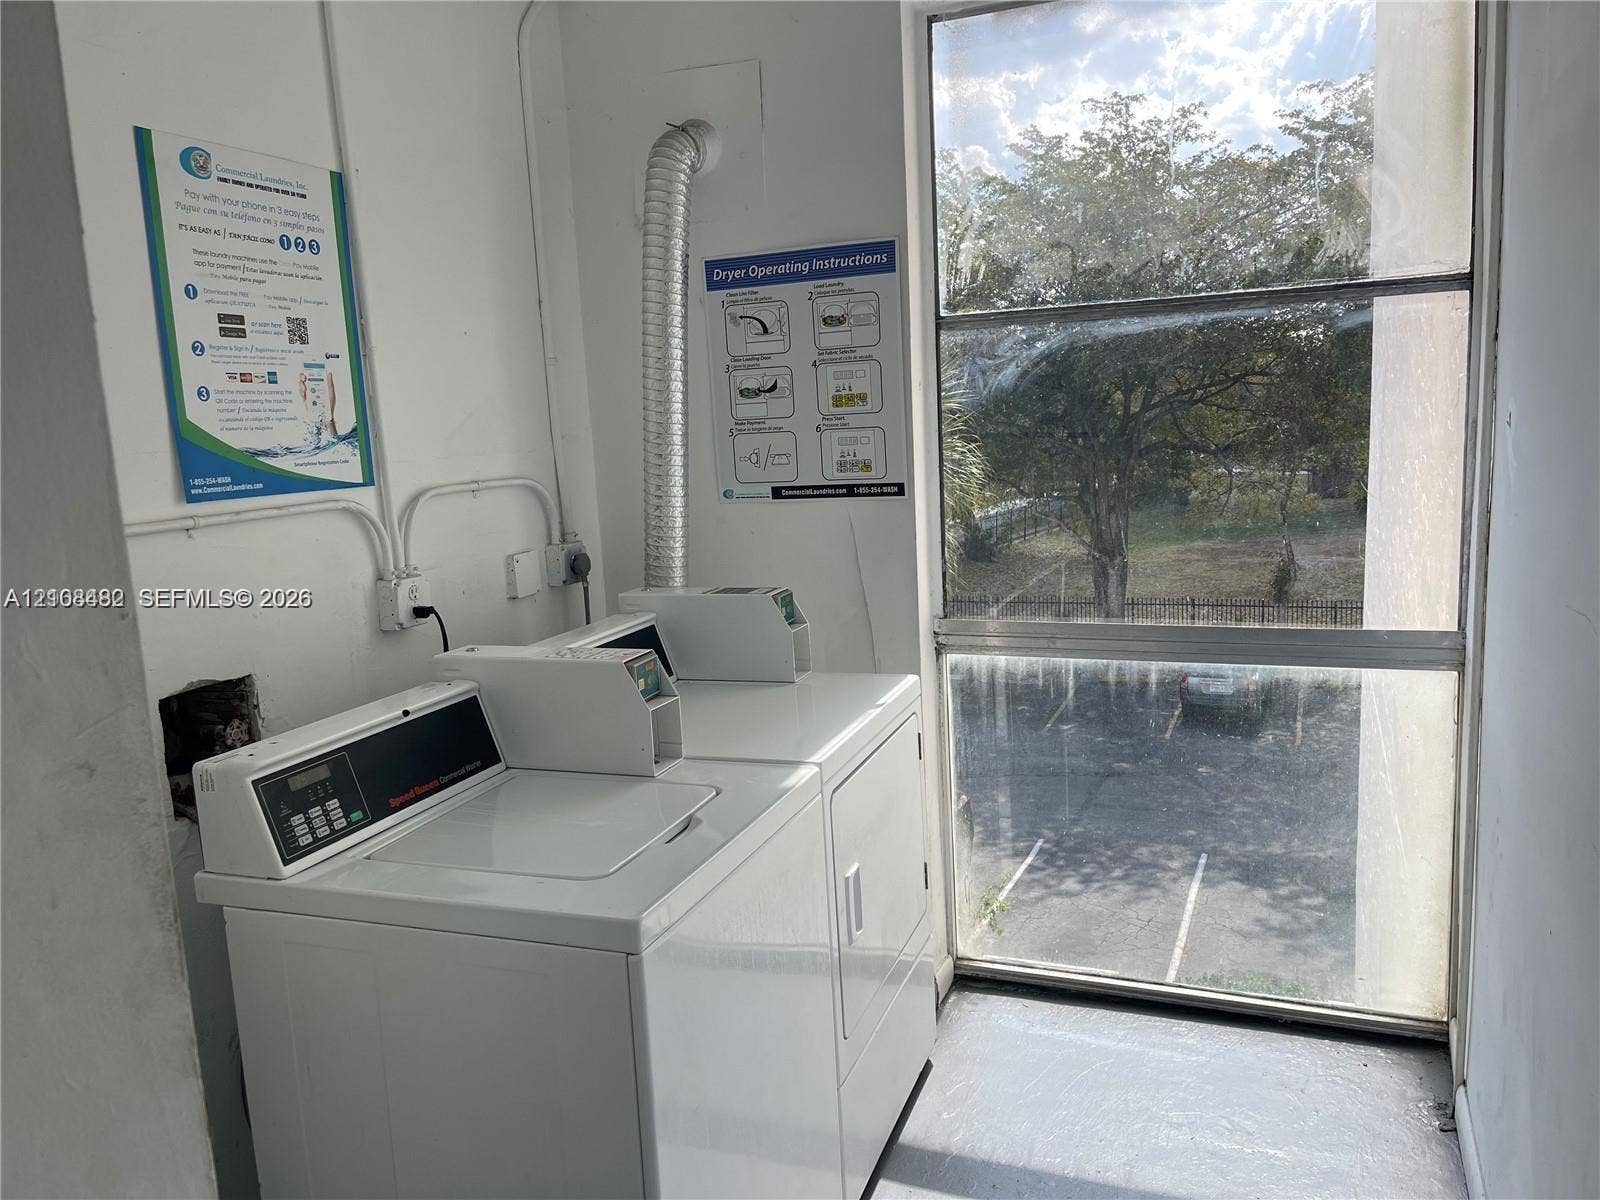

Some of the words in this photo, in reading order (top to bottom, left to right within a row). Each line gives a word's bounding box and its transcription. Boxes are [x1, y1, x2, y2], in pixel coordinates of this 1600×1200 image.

[215, 163, 258, 181] Commercial
[184, 188, 201, 201] Pay
[202, 192, 220, 204] with
[221, 196, 240, 208] your
[241, 198, 267, 213] phone
[269, 204, 276, 214] in
[277, 205, 283, 214] 3
[283, 208, 301, 219] easy
[301, 210, 320, 222] steps
[175, 201, 201, 214] Pague
[203, 206, 218, 215] con
[220, 209, 229, 218] su
[262, 217, 272, 225] en
[306, 226, 325, 235] pasos
[178, 223, 189, 231] IT'S
[198, 226, 212, 235] EASY
[228, 231, 241, 239] TAN
[192, 249, 209, 257] These
[209, 250, 231, 260] laundry
[231, 254, 258, 264] machines
[268, 258, 277, 266] the
[193, 259, 207, 267] app
[207, 260, 216, 268] for
[216, 263, 242, 273] payment
[713, 266, 747, 283] Dryer
[749, 258, 811, 277] Operating
[812, 251, 888, 271] Instructions
[203, 287, 229, 296] Download
[807, 291, 813, 301] 2
[270, 321, 282, 329] here
[724, 364, 730, 373] 3
[811, 359, 817, 368] 4
[728, 428, 734, 437] 5
[815, 423, 822, 433] 6
[189, 476, 231, 486] 1-855-254-WASH
[190, 482, 264, 495] www.CommercialLaundries.com
[781, 487, 847, 496] CommercialLaundries.com
[853, 486, 898, 495] 1-855-254-WASH
[388, 789, 416, 808] Speed
[413, 778, 440, 796] Queen
[439, 766, 467, 784] Commercial
[465, 760, 482, 773] Washer
